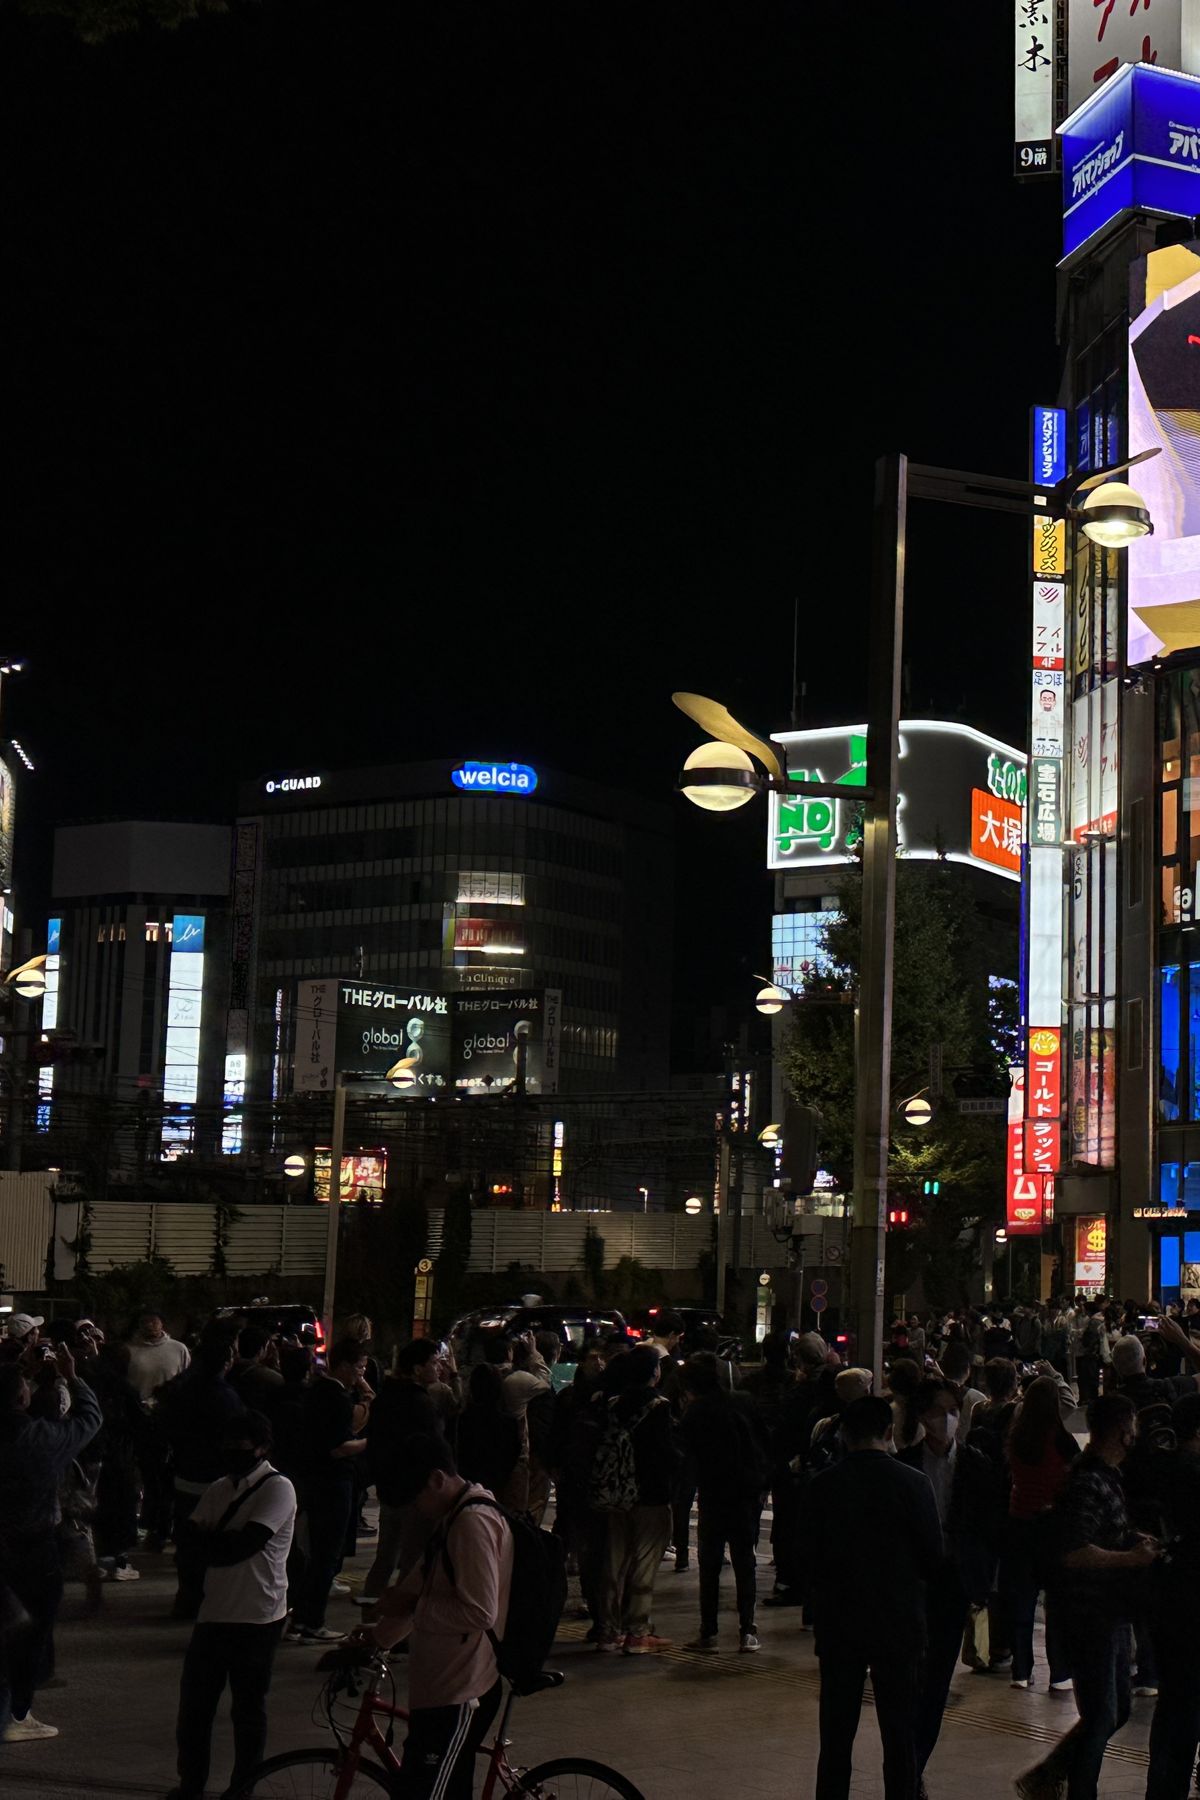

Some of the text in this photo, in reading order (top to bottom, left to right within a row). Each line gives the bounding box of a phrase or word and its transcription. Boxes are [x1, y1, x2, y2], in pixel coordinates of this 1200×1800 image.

[1041, 658, 1056, 668] 4F
[266, 776, 322, 793] O-GUARD
[459, 765, 530, 789] welcia
[1037, 764, 1058, 843] 宝石広場
[342, 988, 448, 1014] THEグローバル社
[362, 1027, 404, 1055] global
[463, 1032, 511, 1060] global
